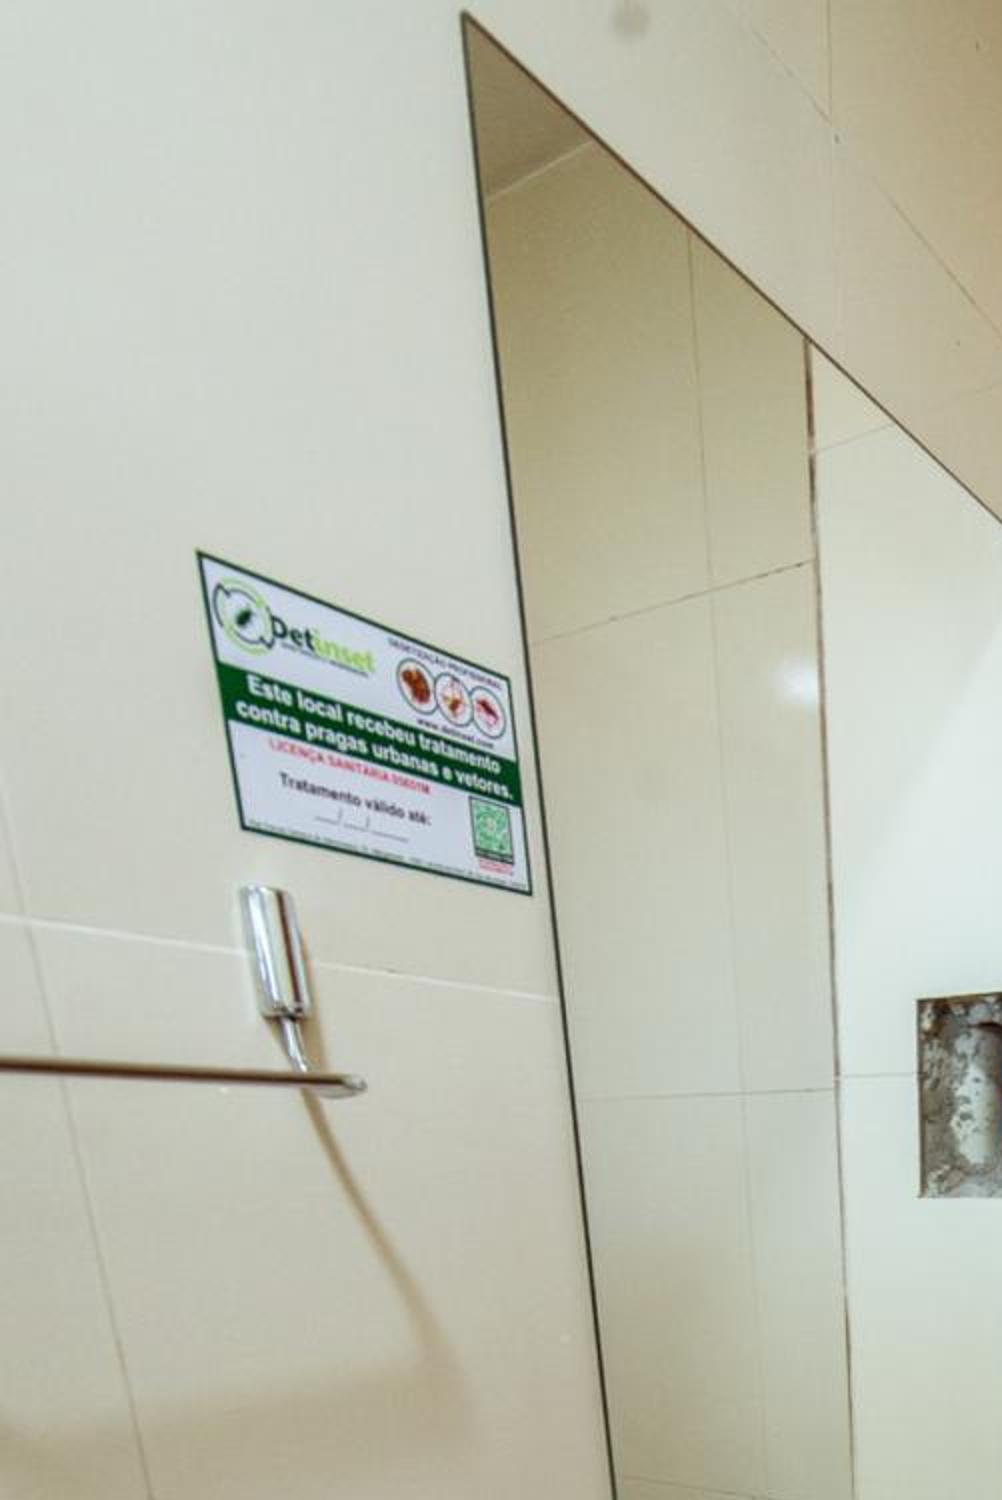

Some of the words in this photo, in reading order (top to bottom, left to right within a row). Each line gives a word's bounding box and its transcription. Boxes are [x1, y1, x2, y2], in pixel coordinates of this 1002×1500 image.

[235, 701, 301, 734] contra
[305, 721, 368, 756] pragas
[372, 742, 439, 777] urbanas
[442, 766, 453, 781] e
[455, 770, 514, 799] vetores.
[246, 674, 292, 706] Este
[297, 689, 343, 722] local
[347, 711, 417, 746] recebeu
[419, 733, 501, 774] tratamento
[279, 771, 361, 807] Tratamento
